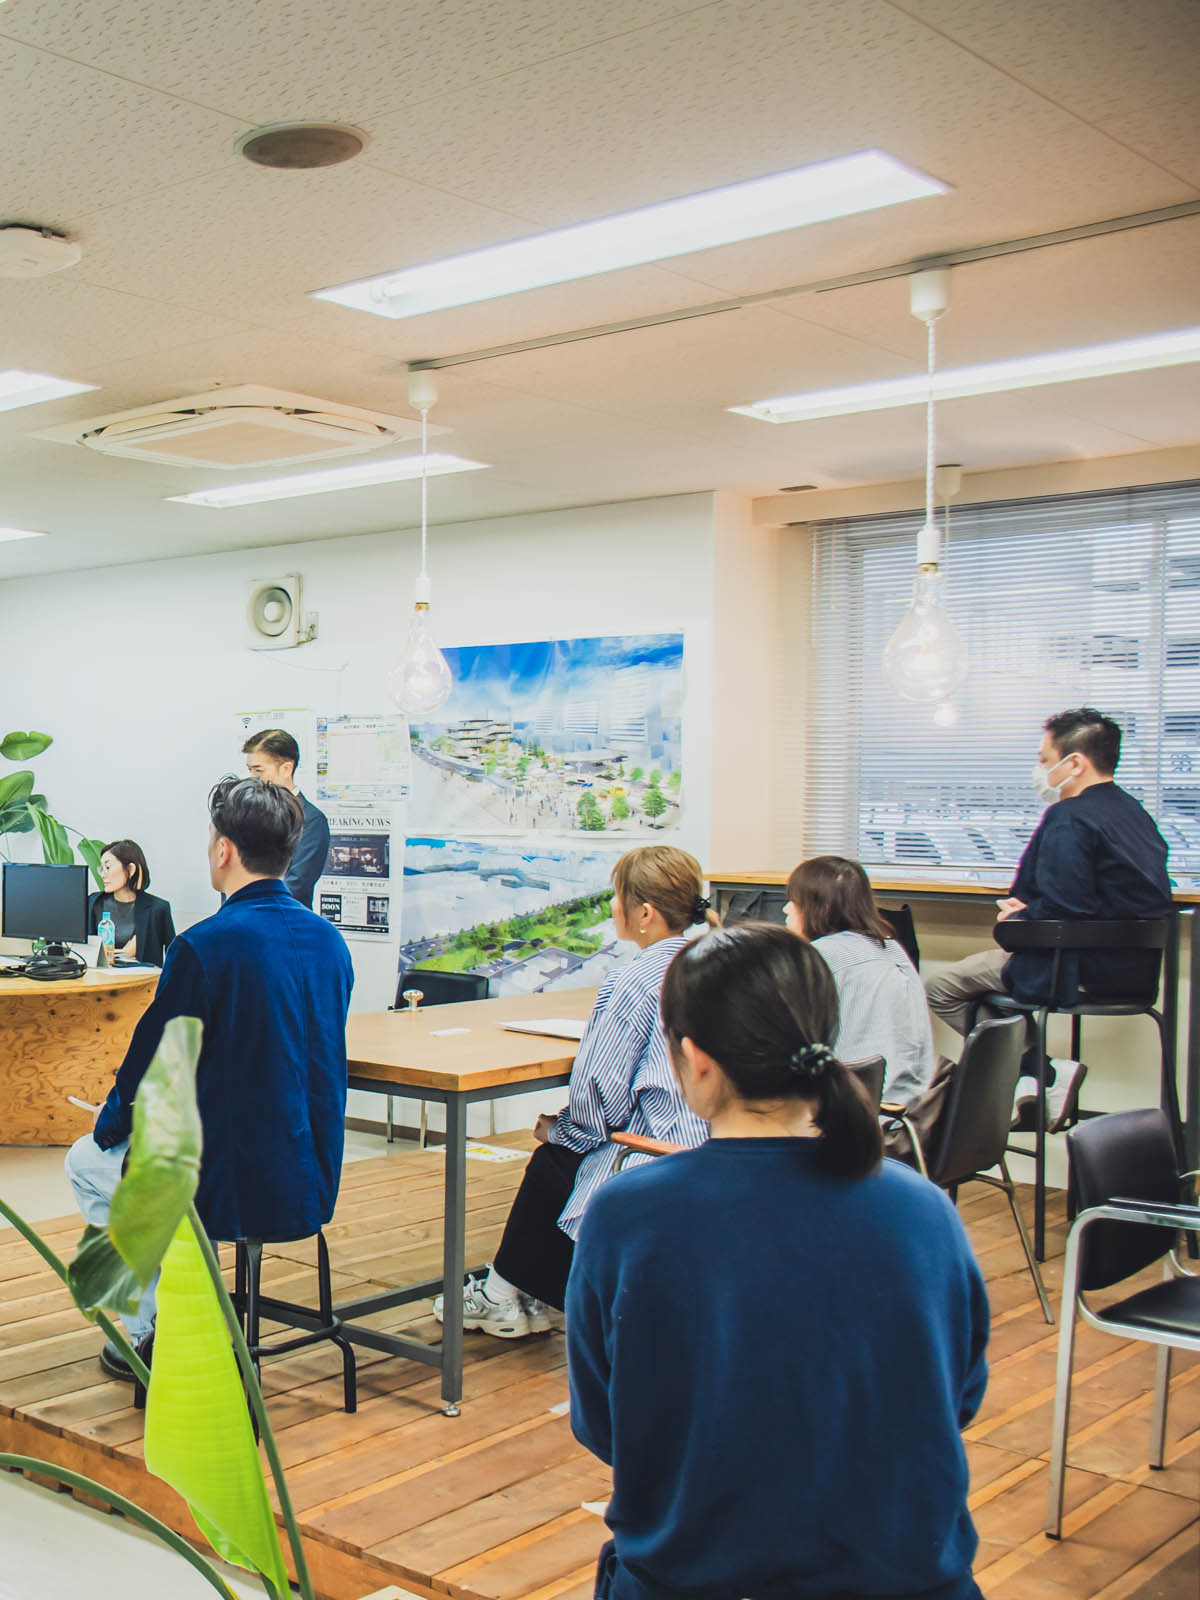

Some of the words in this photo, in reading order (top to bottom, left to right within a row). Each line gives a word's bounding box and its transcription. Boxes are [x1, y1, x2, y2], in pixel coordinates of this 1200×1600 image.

[366, 817, 391, 827] NEWS
[321, 903, 340, 911] SOON
[464, 1299, 478, 1312] N
